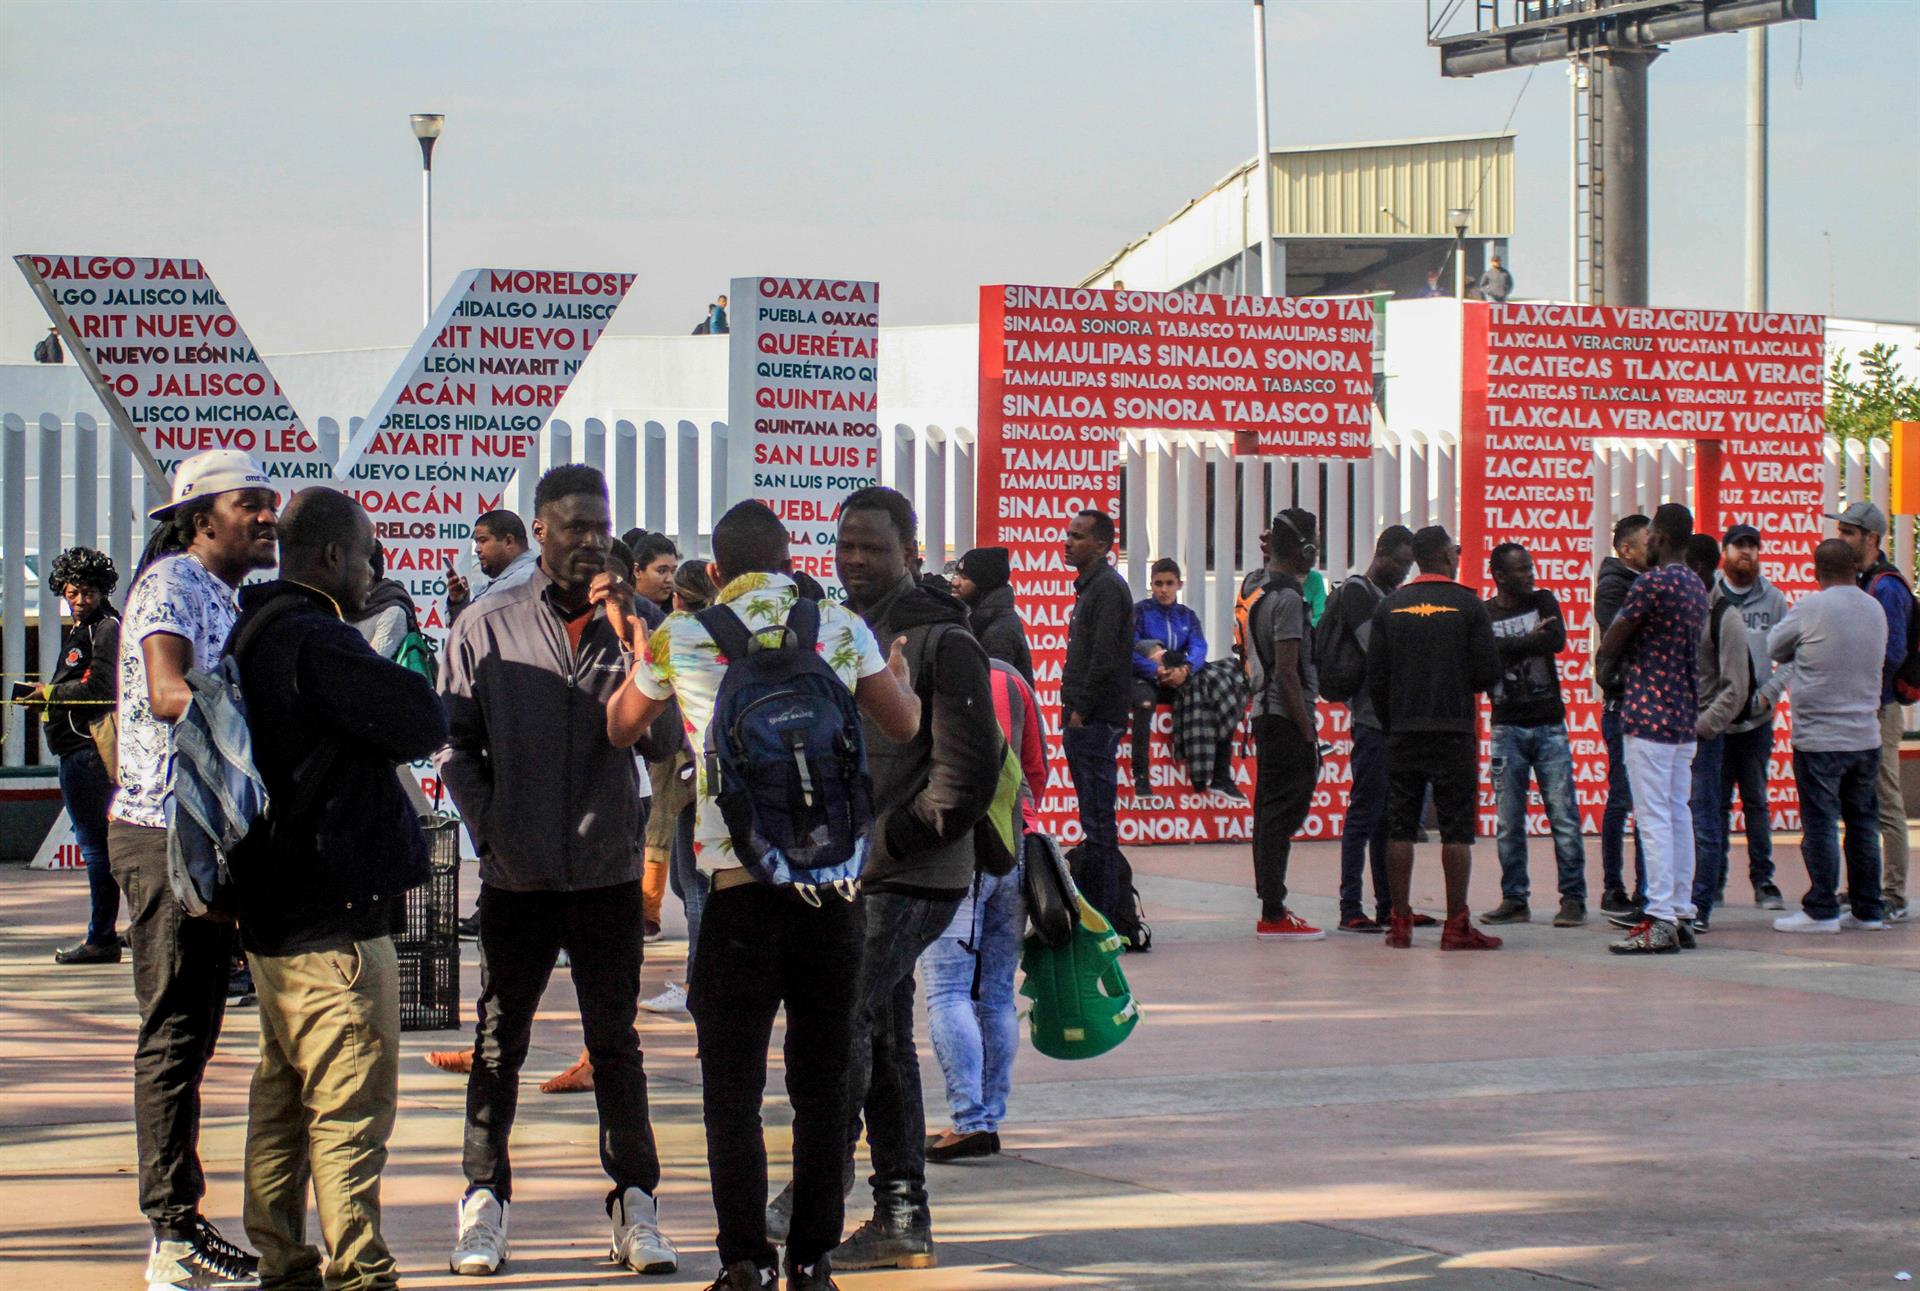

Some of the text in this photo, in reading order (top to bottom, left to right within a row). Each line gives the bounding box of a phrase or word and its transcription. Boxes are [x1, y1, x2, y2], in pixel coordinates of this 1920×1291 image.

[490, 270, 617, 296] MORELOS
[760, 277, 866, 303] OAXACA
[102, 288, 187, 306] JALISCO
[1004, 286, 1108, 312] SINALOA
[1114, 291, 1216, 316] SONORA
[1222, 295, 1330, 320] TABASCO
[452, 300, 537, 318] HIDALGO
[759, 307, 817, 324] PUEBLA
[1489, 303, 1606, 328] TLAXCALA
[1612, 307, 1728, 332] VERACRUZ
[136, 315, 237, 338] NUEVO
[1003, 316, 1076, 333] SINALOA
[1080, 318, 1153, 336] SONORA
[1157, 321, 1234, 339] TABASCO
[1238, 324, 1337, 343] TAMAULIPAS
[480, 326, 576, 351] NUEVO
[1487, 332, 1567, 349] TLAXCALA
[1571, 335, 1653, 351] VERACRUZ
[1657, 337, 1729, 354] YUCATAN
[1732, 340, 1812, 357] TLAXCALA
[96, 346, 170, 365] NUEVO
[174, 342, 228, 365] LEÓN
[423, 354, 475, 374] LEÓN
[479, 358, 560, 376] NAYARIT
[1003, 339, 1363, 373] TAMAULIPAS SINALOA SONORA
[757, 360, 856, 381] QUERÉTARO
[1487, 354, 1613, 379] ZACATECAS
[1623, 358, 1739, 382] TLAXCALA
[147, 373, 266, 397] JALISCO
[1003, 369, 1107, 388] TAMAULIPAS
[1110, 372, 1183, 390] SINALOA
[1187, 375, 1257, 392] SONORA
[1262, 377, 1336, 394] TABASCO
[1486, 383, 1824, 406] ZACATECAS TLAXCALA VERACRUZ ZACATEC
[1002, 394, 1107, 418] SINALOA
[1114, 397, 1215, 421] SONORA
[1221, 400, 1329, 424] TABASCO
[1486, 405, 1603, 429] TLAXCALA
[1608, 408, 1725, 432] VERACRUZ
[455, 414, 542, 431] HIDALGO
[754, 418, 877, 438] QUINTANA ROO
[1002, 424, 1075, 440] SINALOA
[155, 427, 257, 451] NUEVO
[1485, 434, 1566, 451] TLAXCALA
[1730, 440, 1810, 456] TLAXCALA
[754, 443, 803, 466] SAN
[810, 445, 860, 468] LUIS
[415, 461, 466, 481] LEÓN
[754, 473, 786, 488] SAN
[790, 474, 823, 489] LUIS
[1000, 473, 1103, 490] TAMAULIPAS
[1484, 485, 1575, 501] ZACATECAS
[1116, 816, 1208, 841] ONORA
